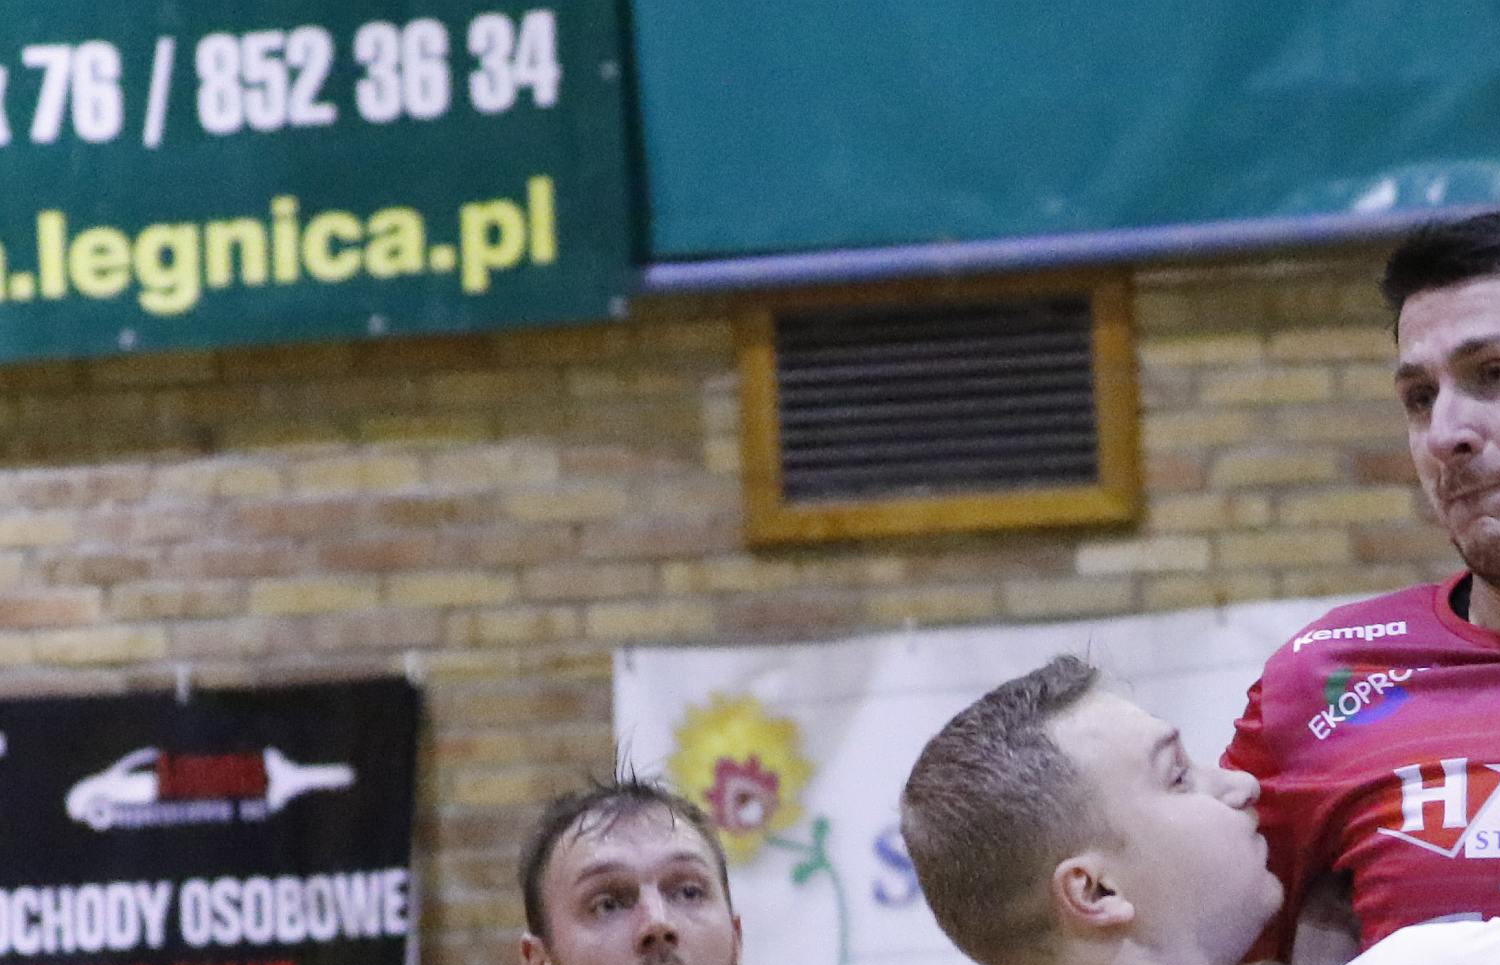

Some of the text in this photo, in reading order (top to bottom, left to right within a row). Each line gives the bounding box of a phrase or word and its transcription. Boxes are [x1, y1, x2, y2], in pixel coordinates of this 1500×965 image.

[22, 40, 122, 143] 76
[142, 37, 175, 148] /
[195, 25, 338, 135] 852
[352, 18, 452, 122] 36
[467, 8, 561, 113] 34
[0, 175, 558, 315] .legnica.pl
[180, 868, 408, 949] OSOBOWE
